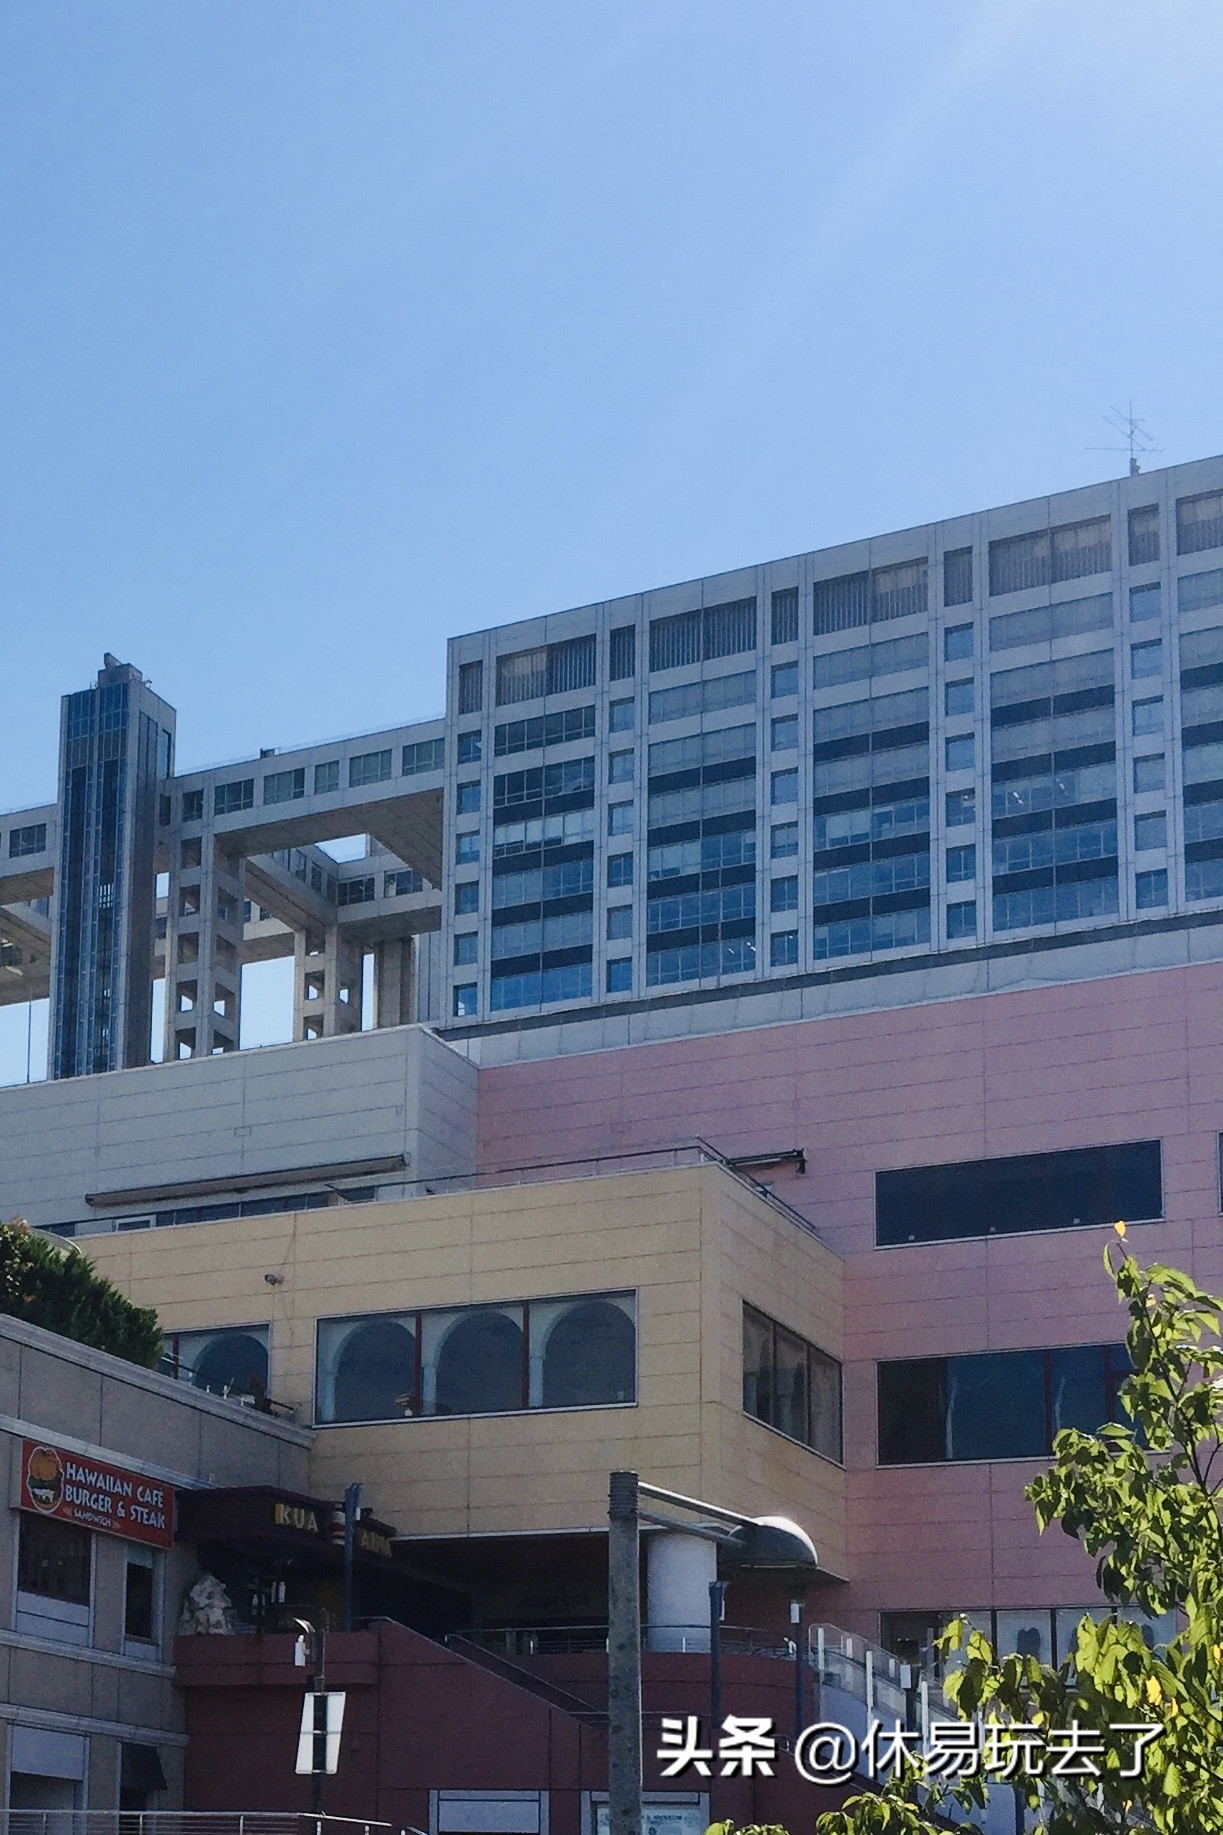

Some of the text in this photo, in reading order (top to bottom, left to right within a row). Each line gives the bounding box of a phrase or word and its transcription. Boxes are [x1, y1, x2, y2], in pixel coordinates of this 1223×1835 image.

[66, 1462, 132, 1497] HAWAIIAN
[65, 1484, 166, 1529] BURGER & STEAK
[73, 1508, 111, 1527] SANDWICH
[275, 1503, 318, 1533] KUA
